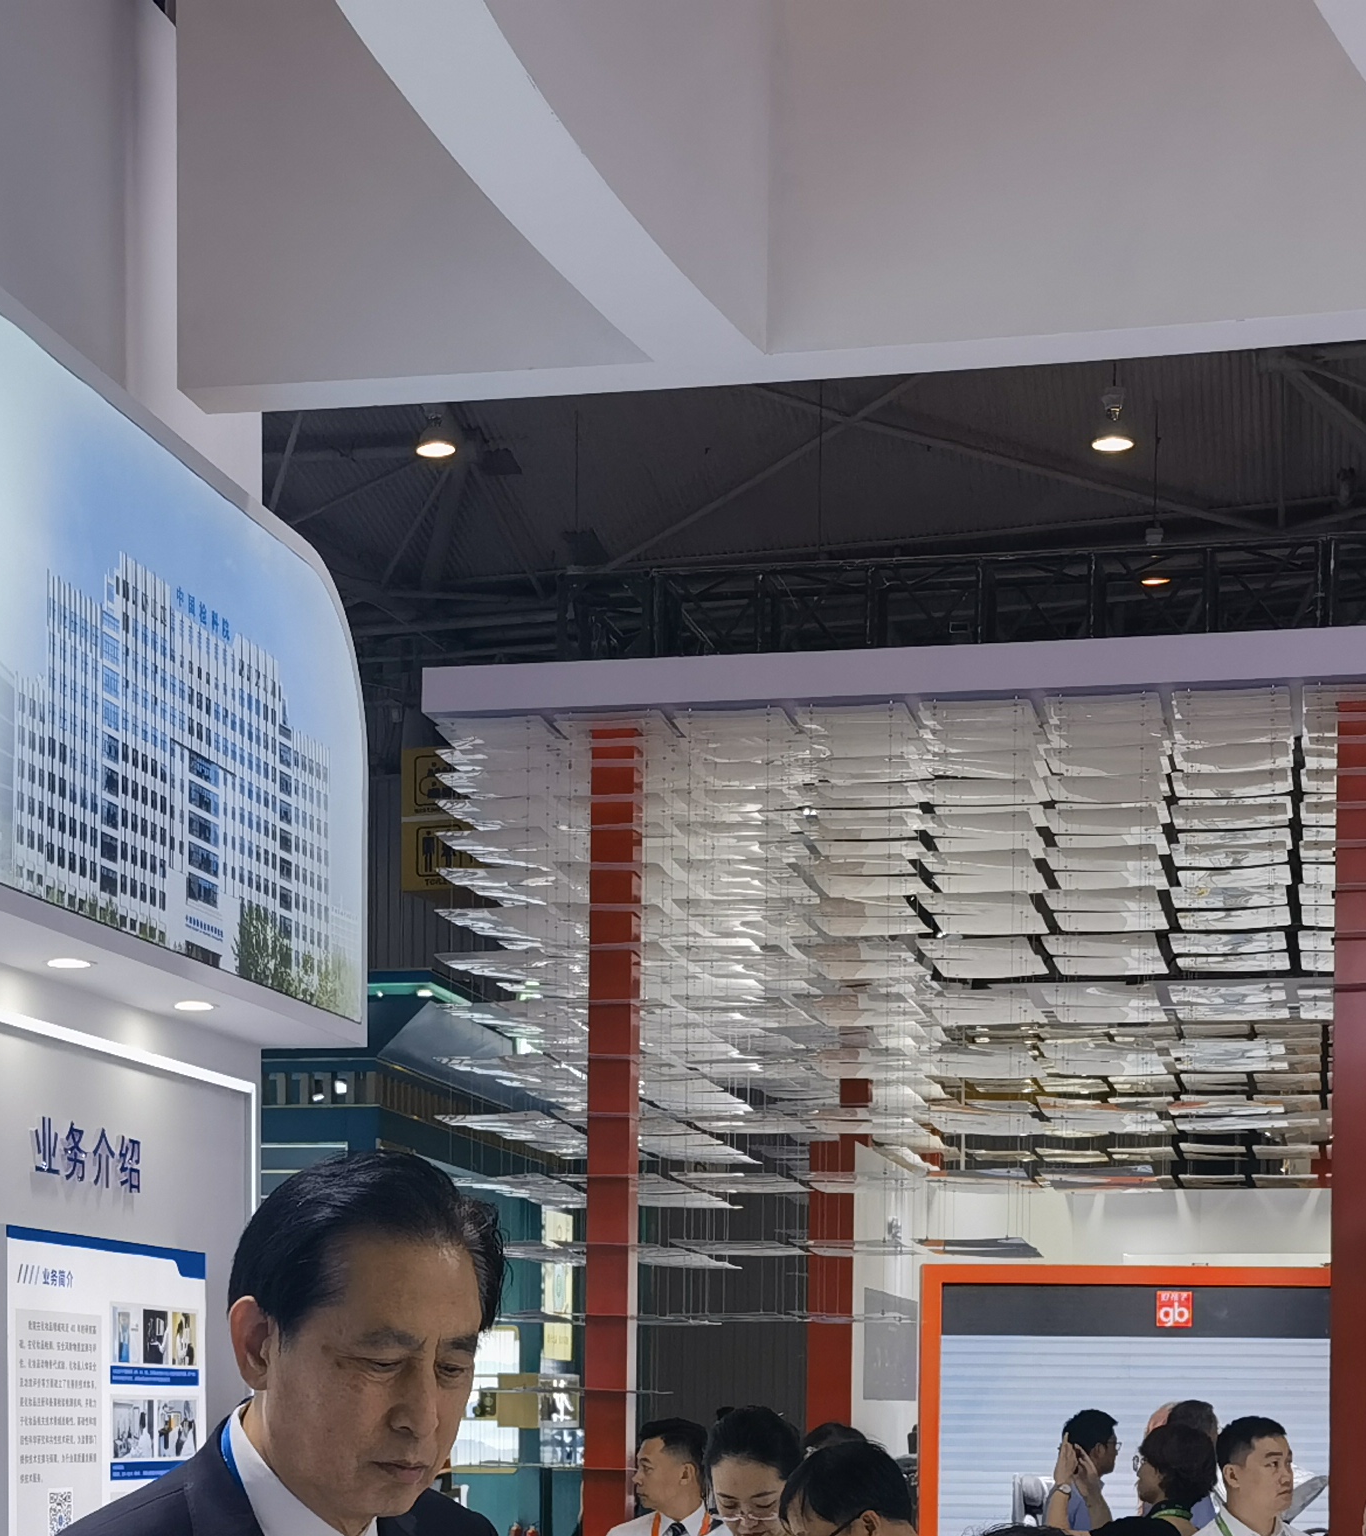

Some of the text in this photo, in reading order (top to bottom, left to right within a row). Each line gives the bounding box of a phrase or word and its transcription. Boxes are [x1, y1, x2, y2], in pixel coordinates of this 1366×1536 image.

[175, 585, 231, 642] 中国检科院
[33, 1116, 143, 1194] 业务介绍
[42, 1268, 74, 1288] 业务简介
[1159, 1301, 1190, 1327] gb
